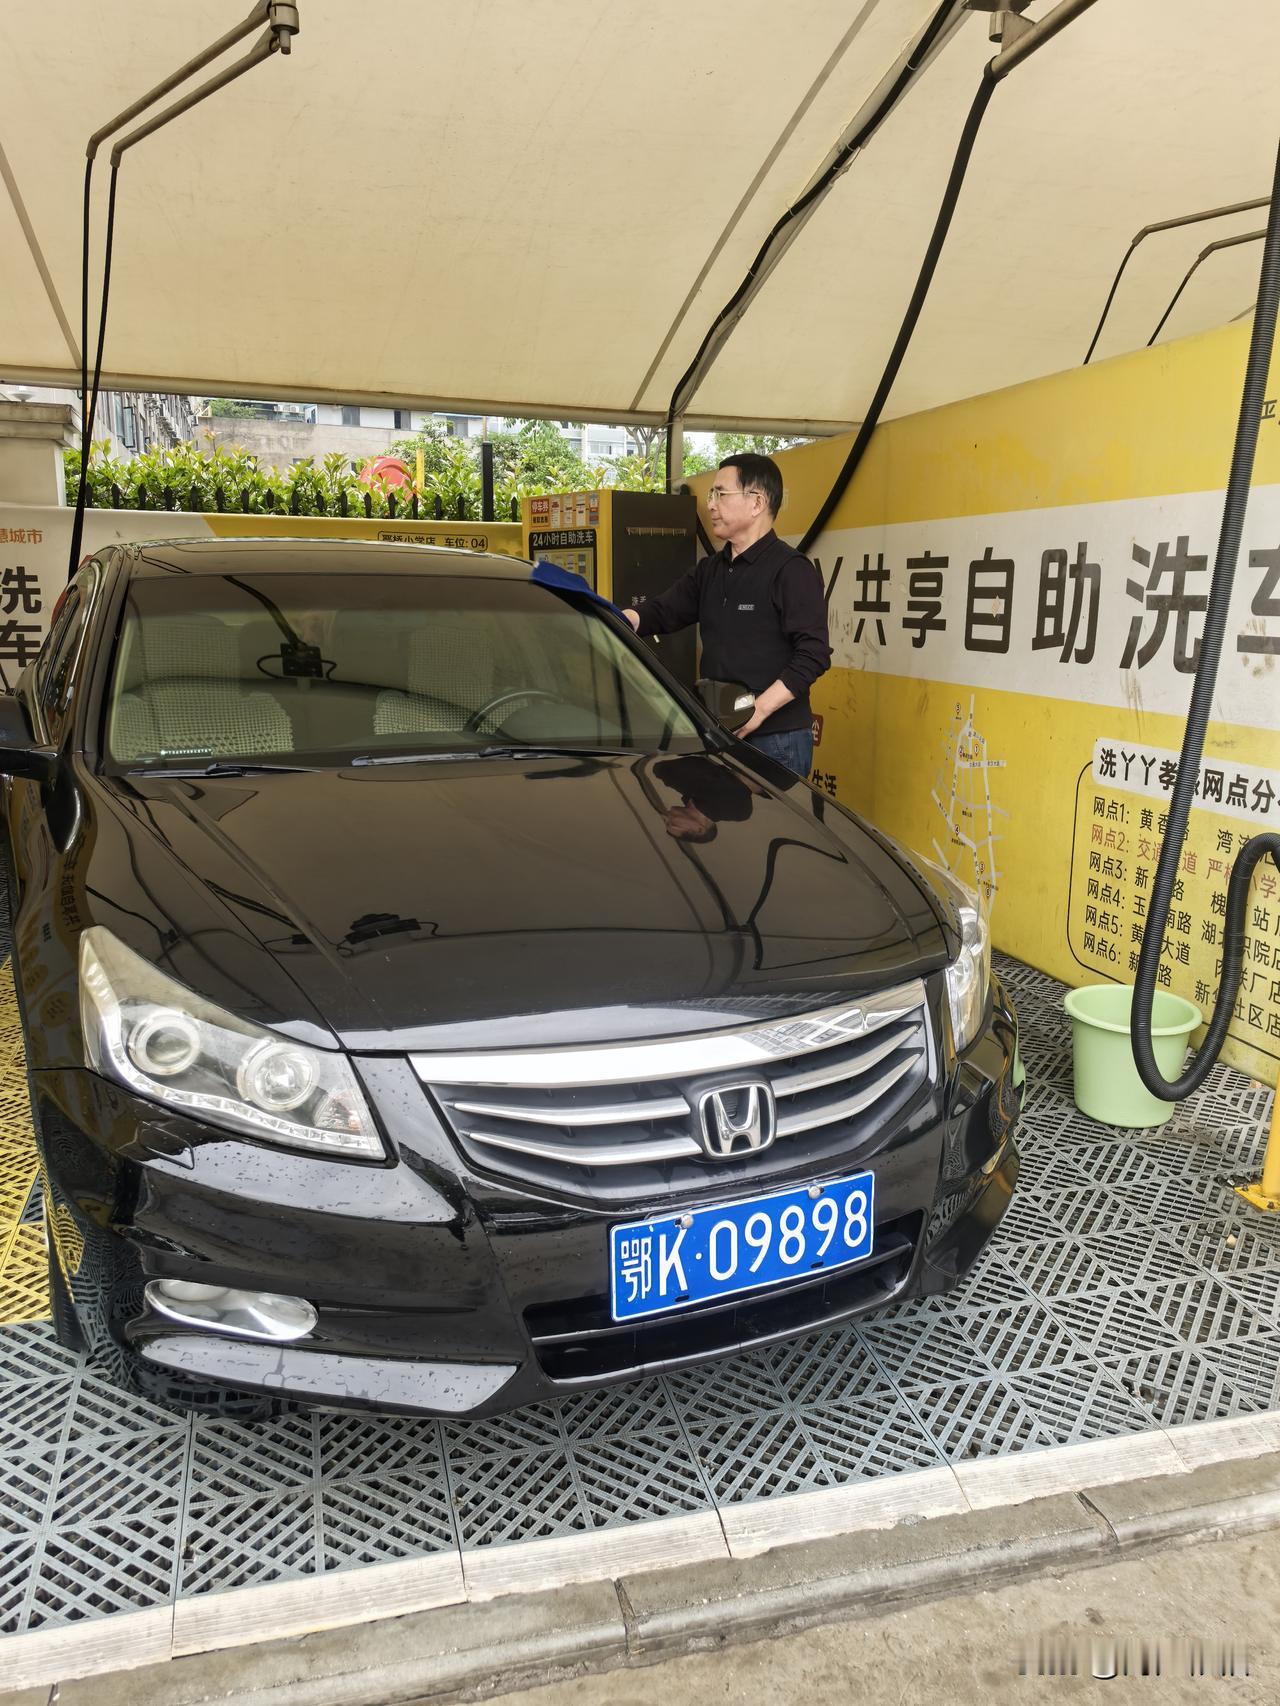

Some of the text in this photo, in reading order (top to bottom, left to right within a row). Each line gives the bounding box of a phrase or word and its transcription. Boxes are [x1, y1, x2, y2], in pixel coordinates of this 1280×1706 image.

[533, 531, 594, 546] 24小时自助洗车
[1099, 747, 1280, 814] 洗丫丫孝网点分
[1136, 838, 1198, 875] 交通道
[1134, 866, 1185, 902] 新路
[1130, 922, 1191, 966] 黄大道
